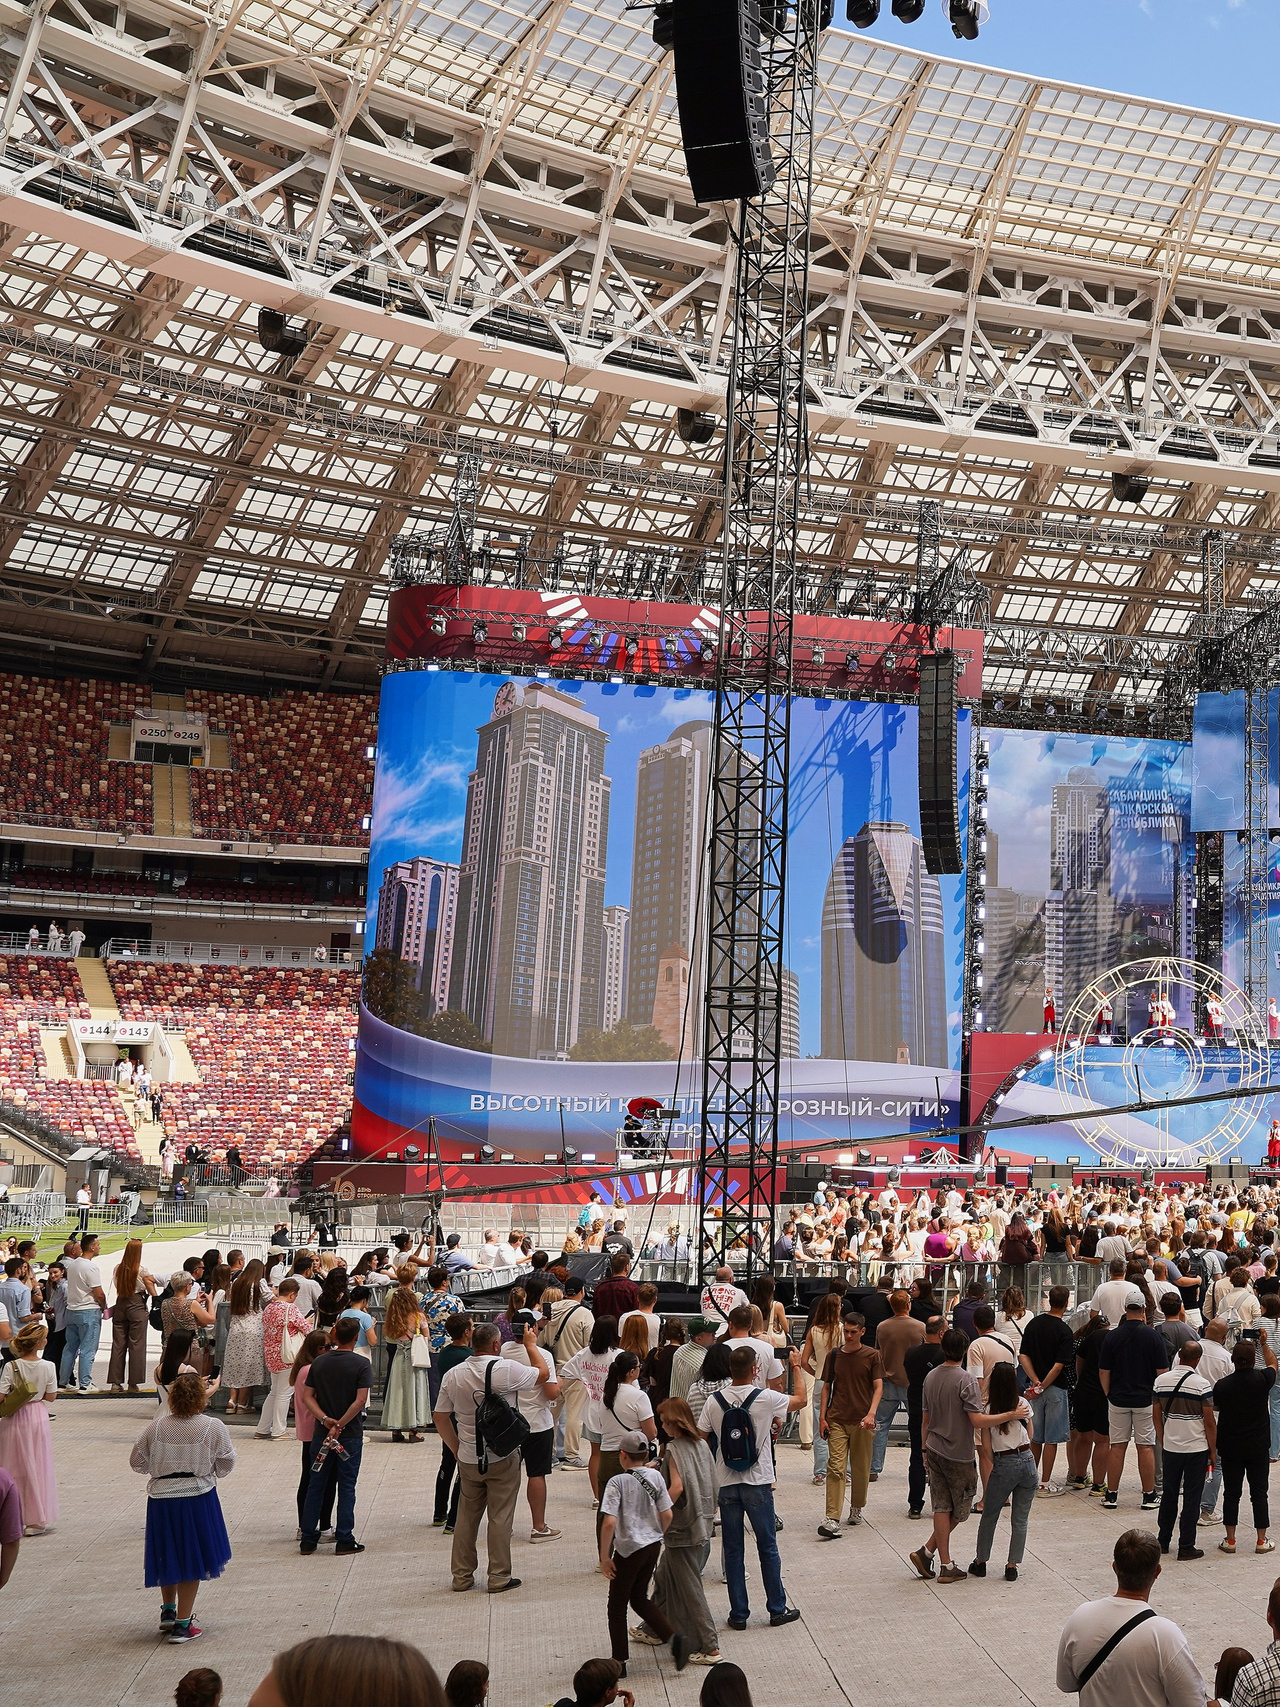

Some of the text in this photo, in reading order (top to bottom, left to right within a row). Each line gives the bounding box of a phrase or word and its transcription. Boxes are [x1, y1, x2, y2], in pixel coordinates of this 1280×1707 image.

[1110, 802, 1174, 815] АЛКАРСКАЯ
[1112, 816, 1177, 830] ЕСПУБЛИКА
[470, 1092, 612, 1113] ВЫСОТНЫЙ
